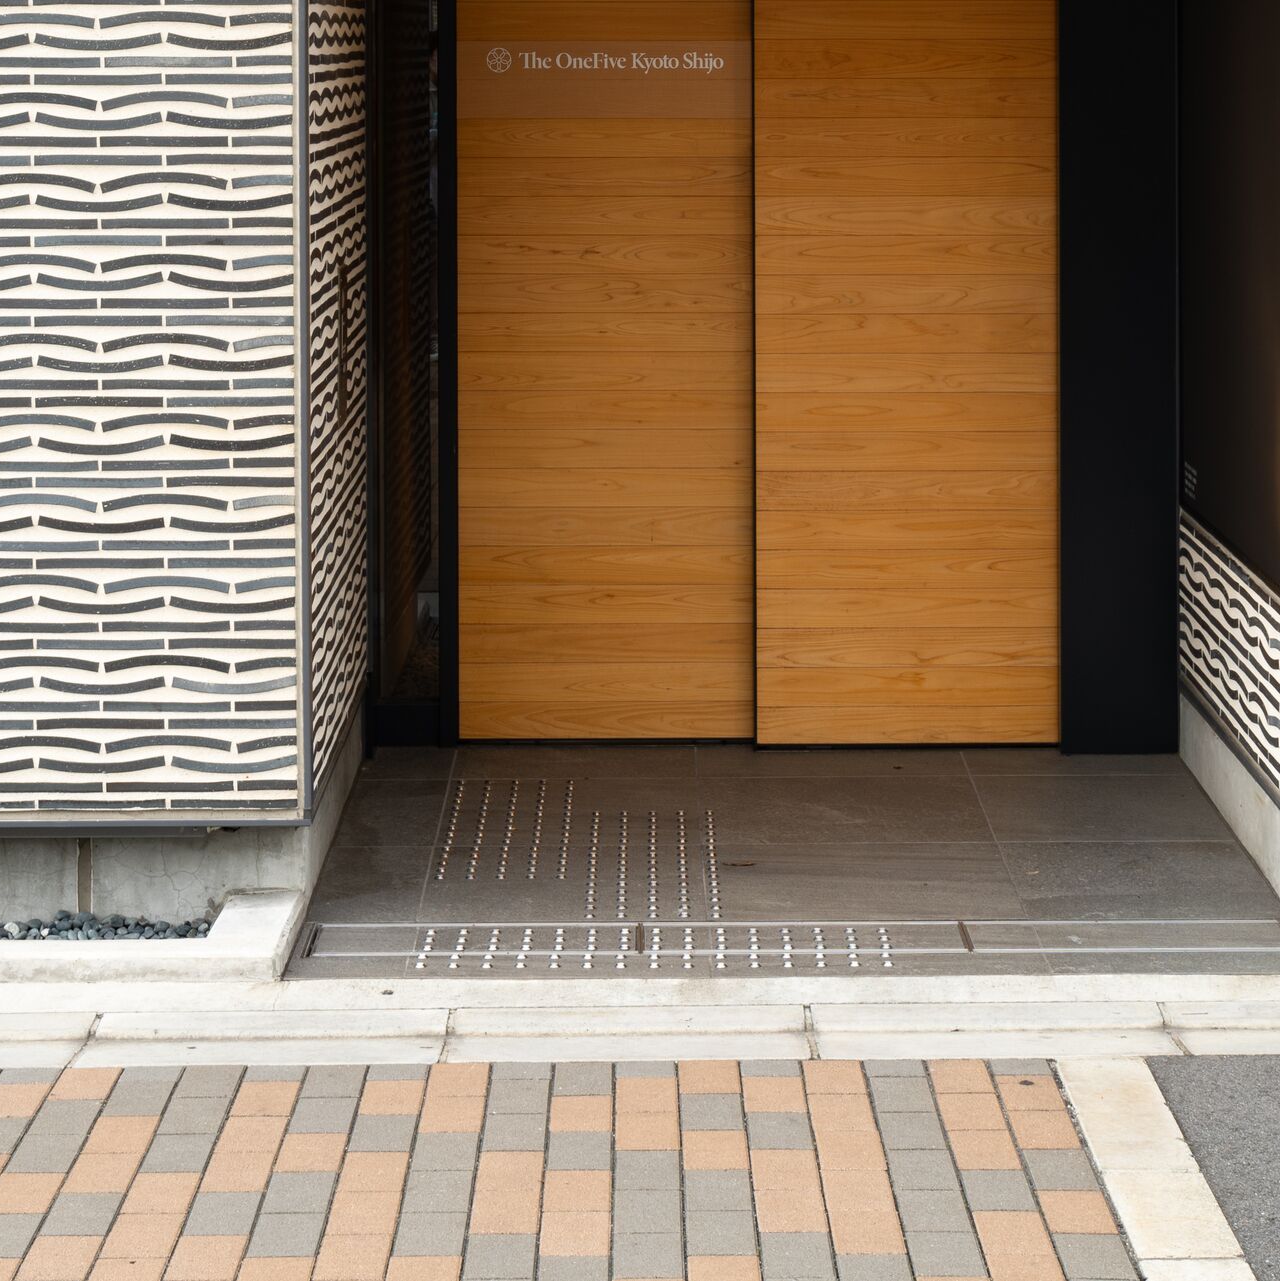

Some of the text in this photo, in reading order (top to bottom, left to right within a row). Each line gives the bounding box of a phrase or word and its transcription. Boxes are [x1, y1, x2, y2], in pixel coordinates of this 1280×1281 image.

[519, 51, 724, 74] The OneFive Kyoto Shijo
